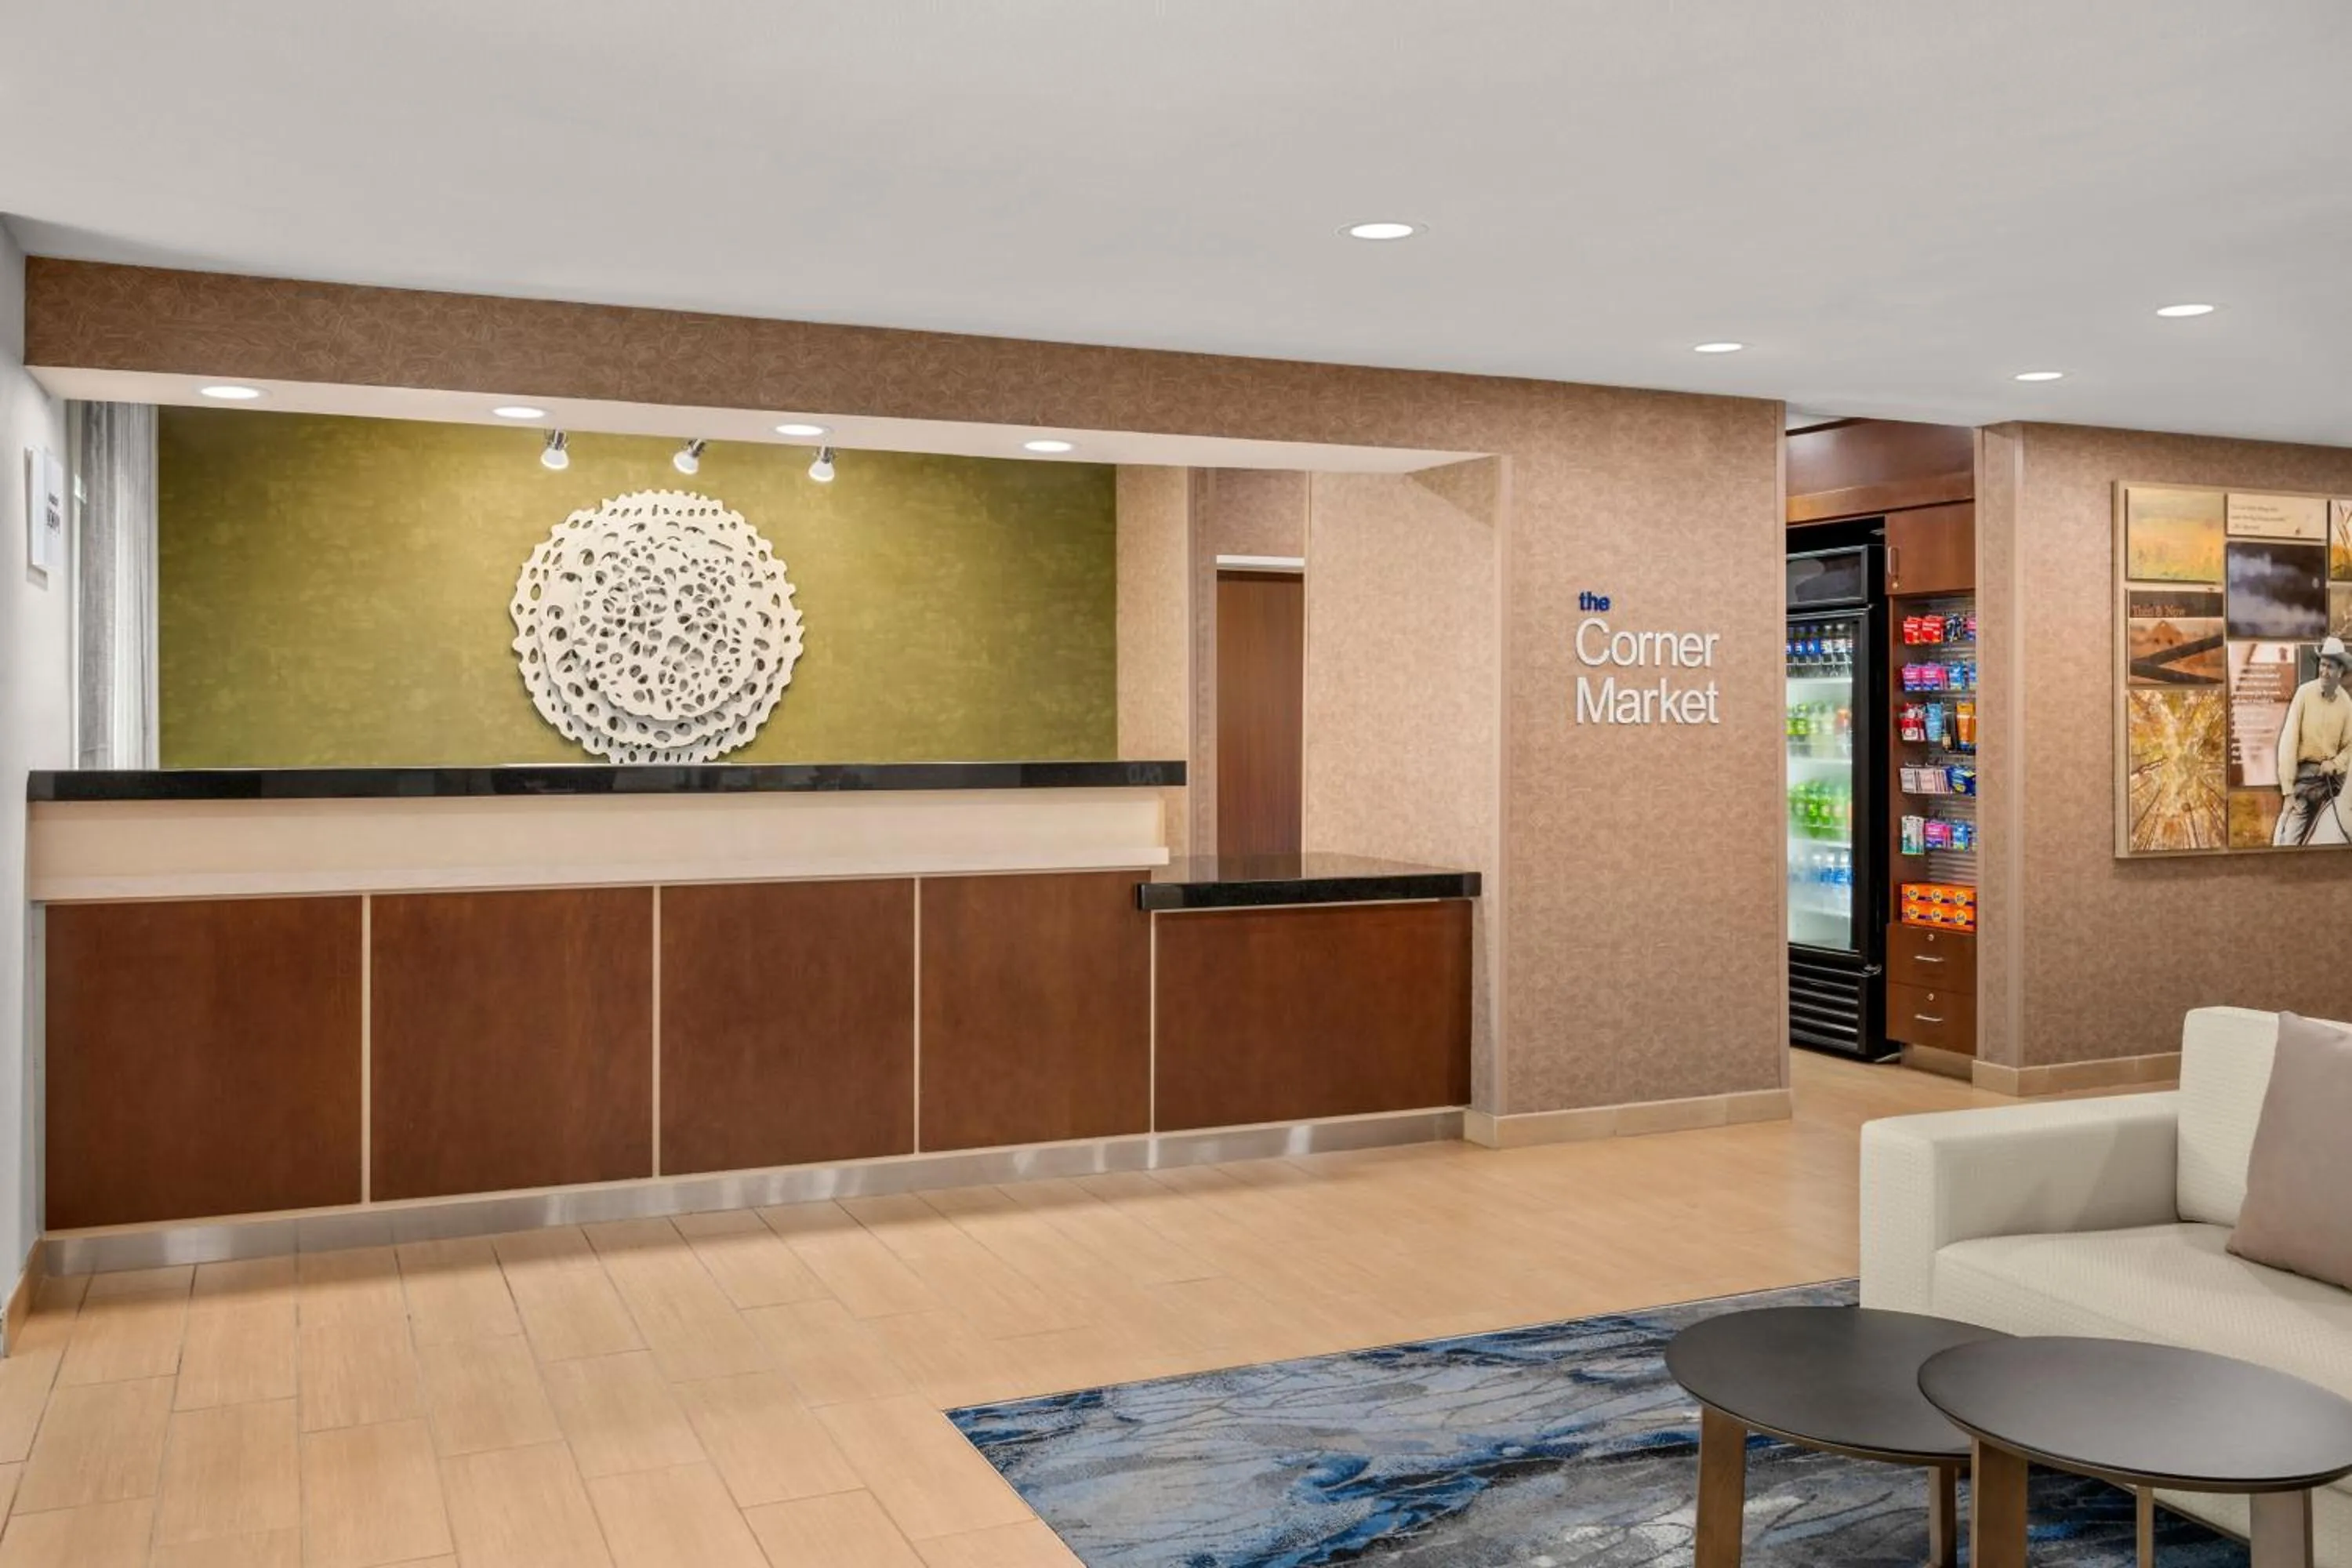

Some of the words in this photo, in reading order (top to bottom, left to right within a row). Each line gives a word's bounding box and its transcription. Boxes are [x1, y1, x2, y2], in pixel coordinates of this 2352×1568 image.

[1579, 591, 1610, 611] the
[1576, 617, 1720, 666] Corner
[1576, 677, 1719, 724] Market
